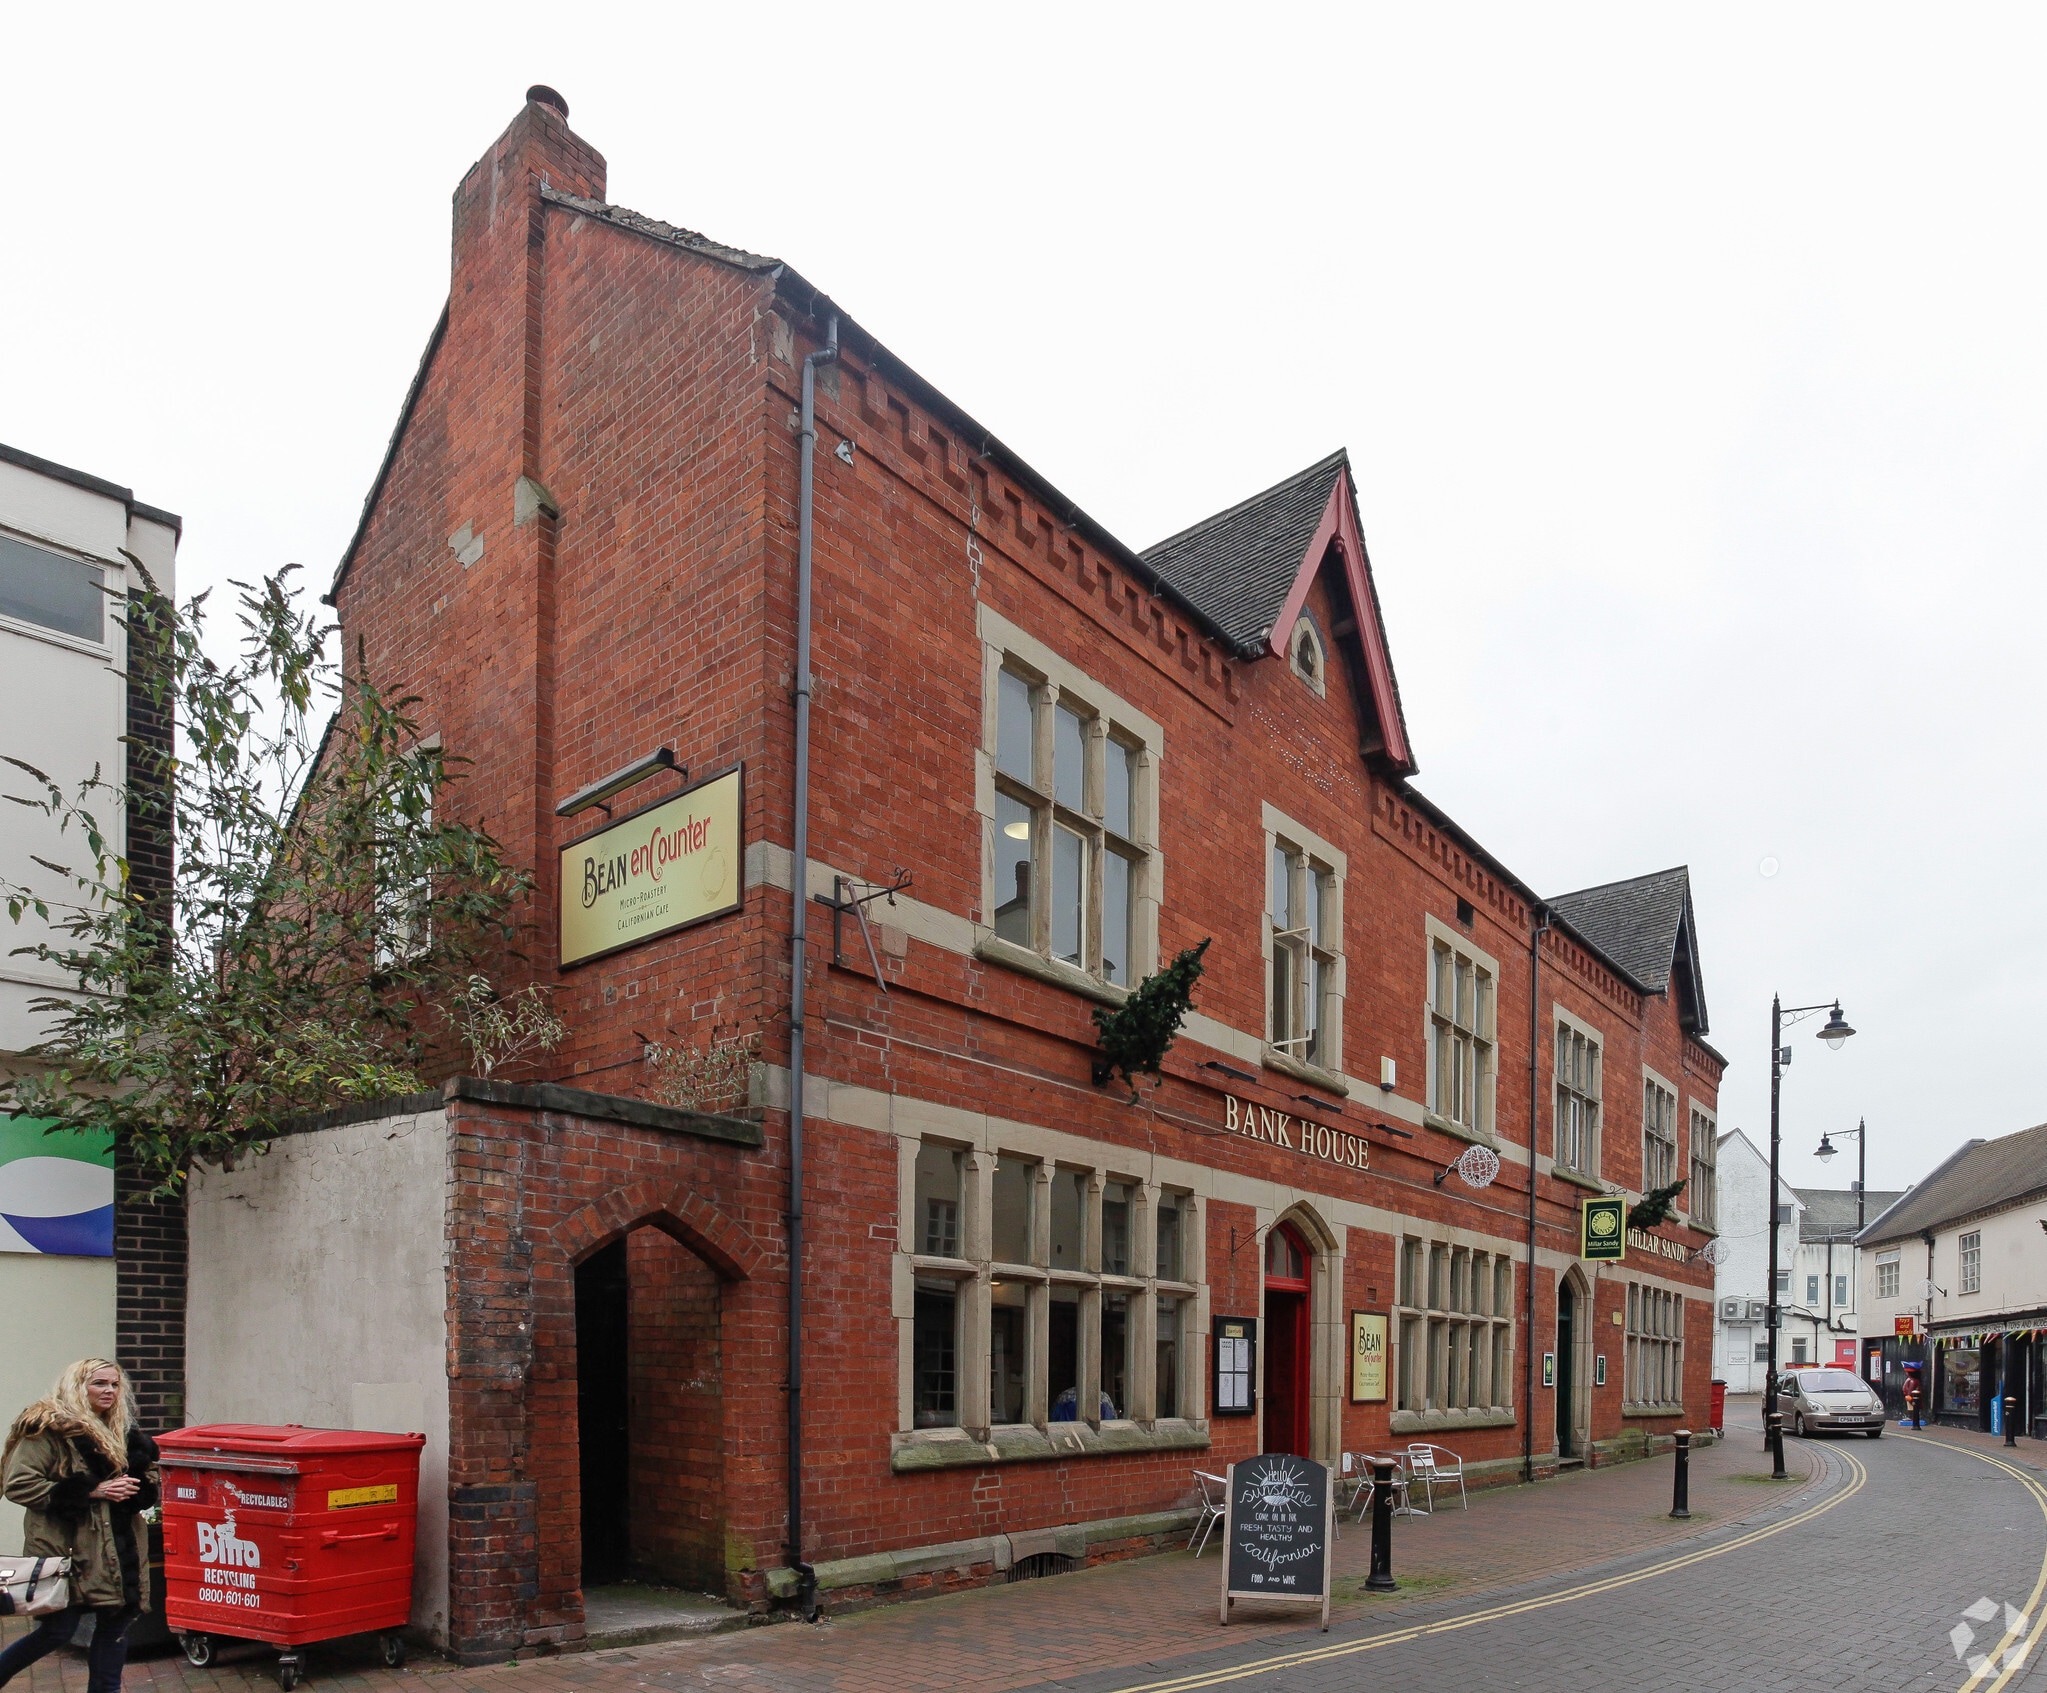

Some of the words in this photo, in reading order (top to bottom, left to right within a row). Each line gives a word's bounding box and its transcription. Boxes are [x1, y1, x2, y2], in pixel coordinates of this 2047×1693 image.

[581, 853, 628, 908] BEAN
[630, 814, 712, 882] enCounter
[619, 884, 668, 911] MICRO-ROASTERY
[617, 909, 655, 931] CALIFORNIAN
[655, 903, 669, 917] CAFE
[1225, 1094, 1293, 1148] BANK
[1300, 1119, 1370, 1170] HOUSE
[1603, 1239, 1619, 1247] Sandy
[1626, 1228, 1659, 1256] MILLAR
[1661, 1238, 1686, 1263] SANDY
[1358, 1326, 1381, 1355] BEAN
[241, 1493, 288, 1509] RECYCLABLES
[1239, 1482, 1317, 1507] sunshine
[1259, 1533, 1293, 1542] HEALTHY
[1267, 1524, 1293, 1533] TASTY
[1297, 1525, 1313, 1533] AND
[204, 1568, 256, 1589] RECYCLING
[1282, 1574, 1296, 1586] WINE
